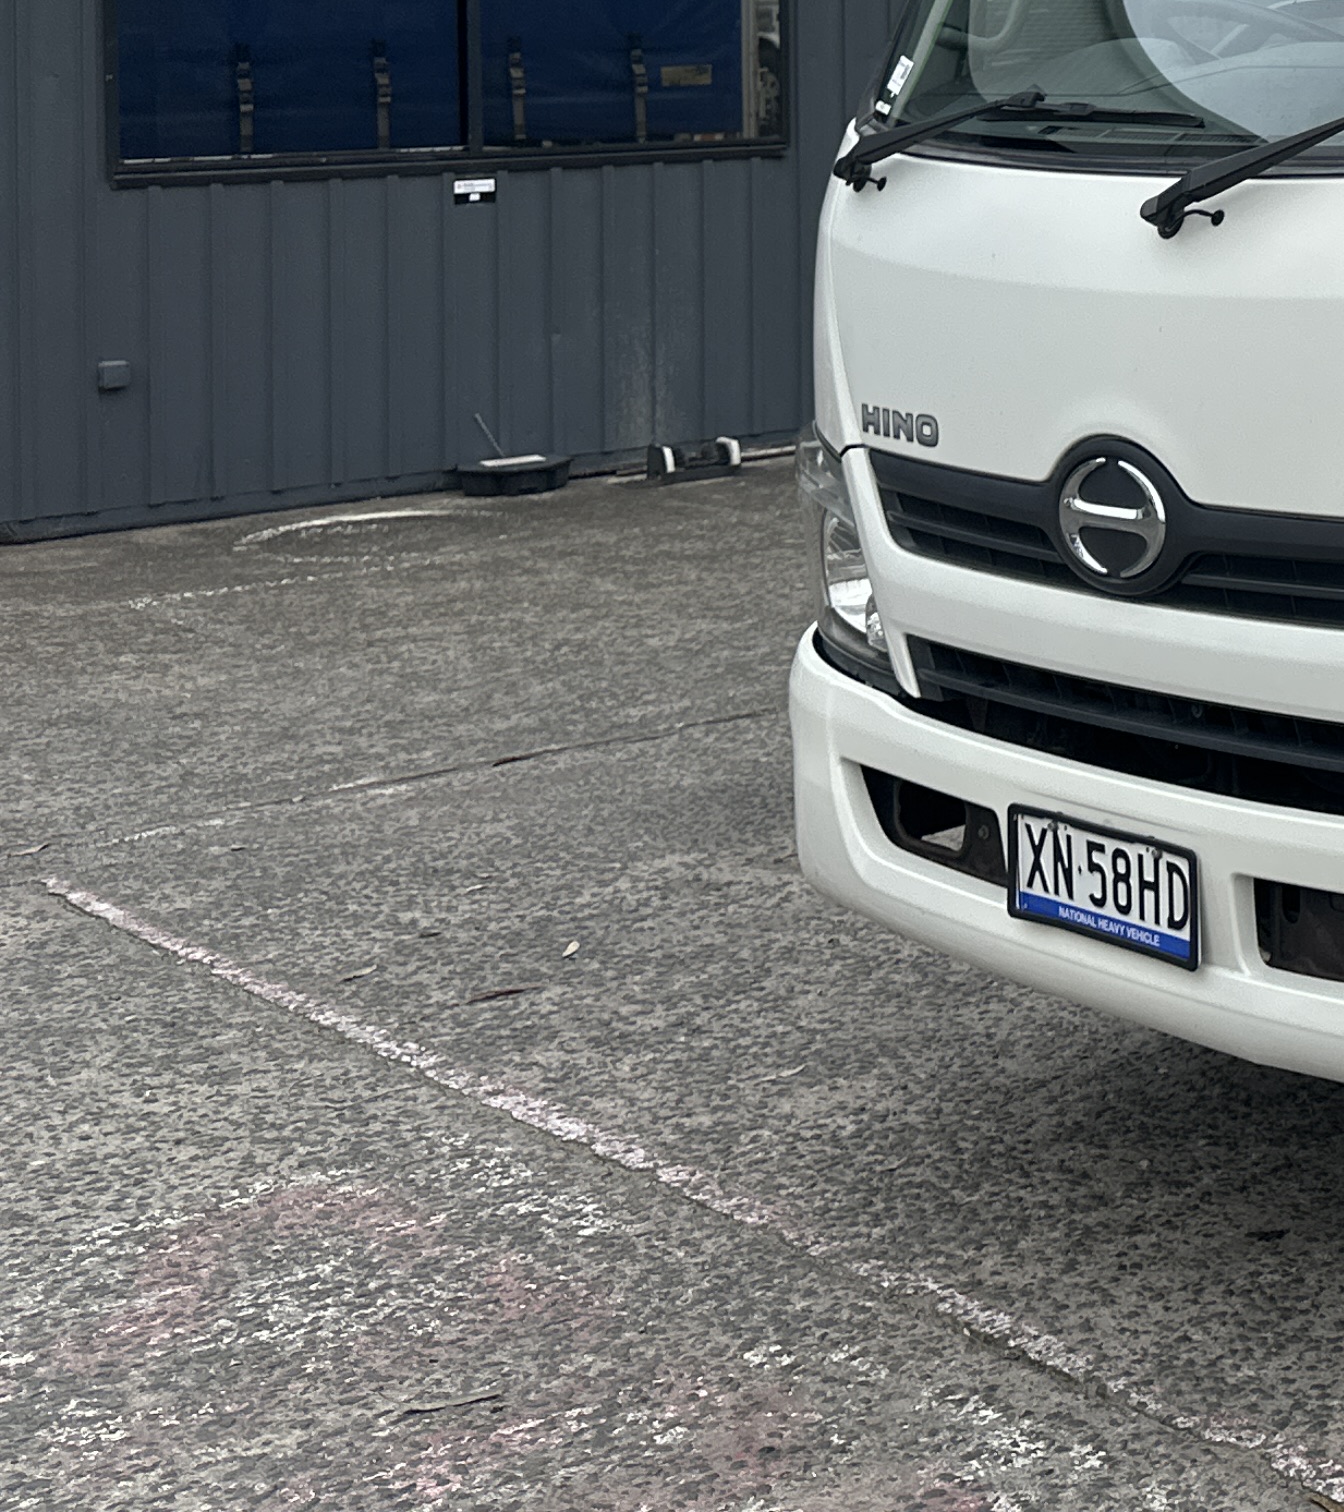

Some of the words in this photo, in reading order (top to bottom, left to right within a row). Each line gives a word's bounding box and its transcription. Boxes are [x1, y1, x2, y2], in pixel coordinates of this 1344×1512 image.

[861, 403, 939, 447] HINO
[1058, 906, 1097, 928] NATIONAL
[1098, 917, 1126, 936] HEAVY
[1126, 925, 1160, 947] VEHICLE
